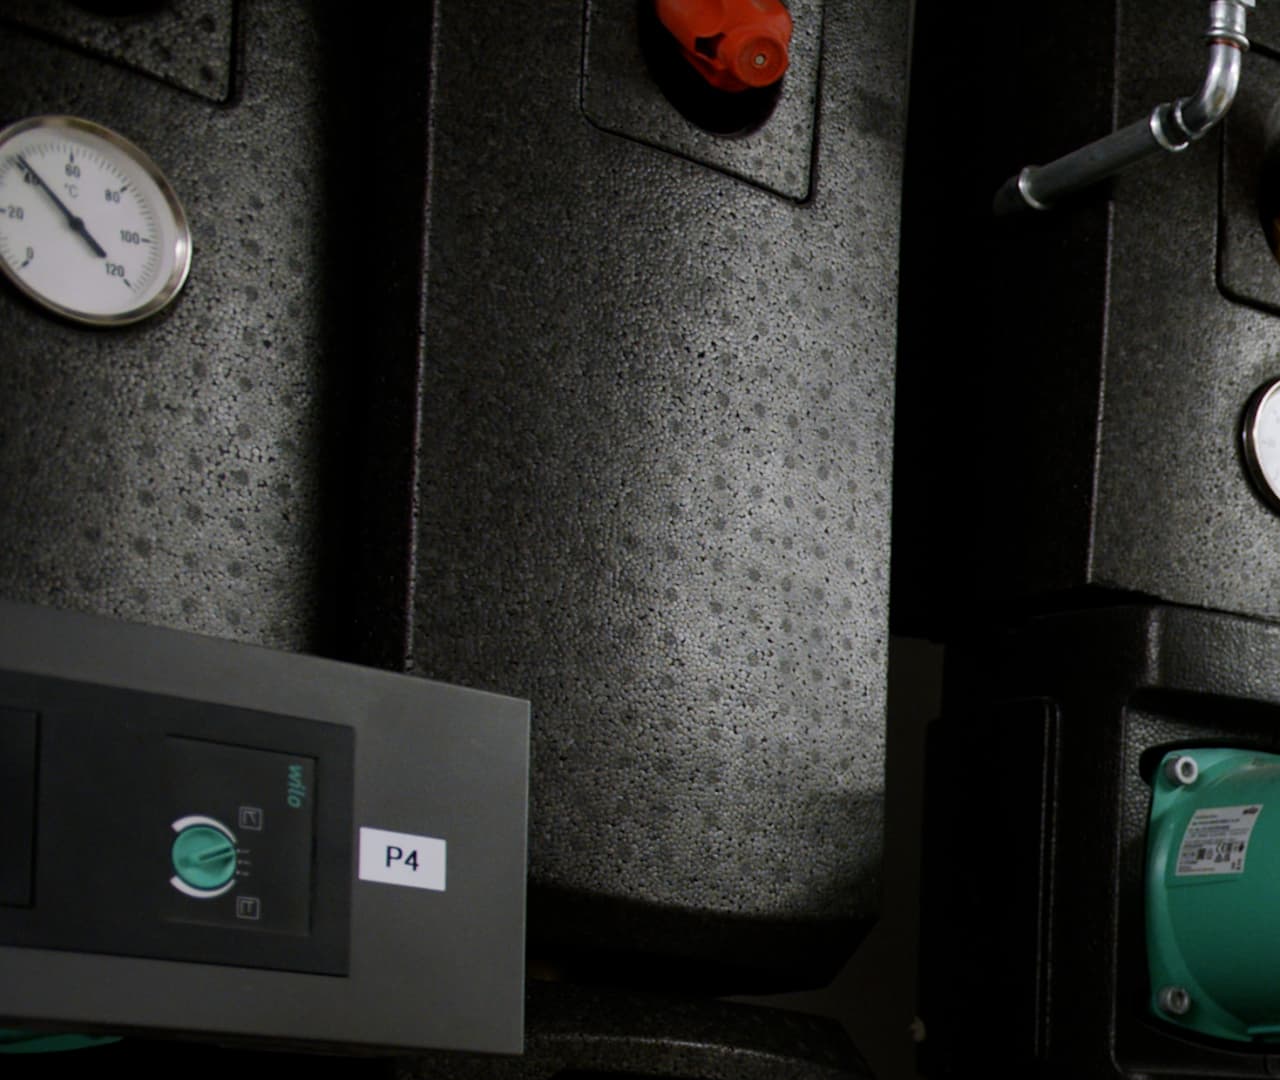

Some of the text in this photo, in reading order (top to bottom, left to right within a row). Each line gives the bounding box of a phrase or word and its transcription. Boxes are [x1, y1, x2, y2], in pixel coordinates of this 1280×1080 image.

[104, 188, 121, 203] 80
[7, 205, 24, 220] 20
[119, 229, 140, 245] 100
[105, 261, 126, 278] 120
[287, 764, 306, 809] wilo
[385, 845, 420, 872] P4
